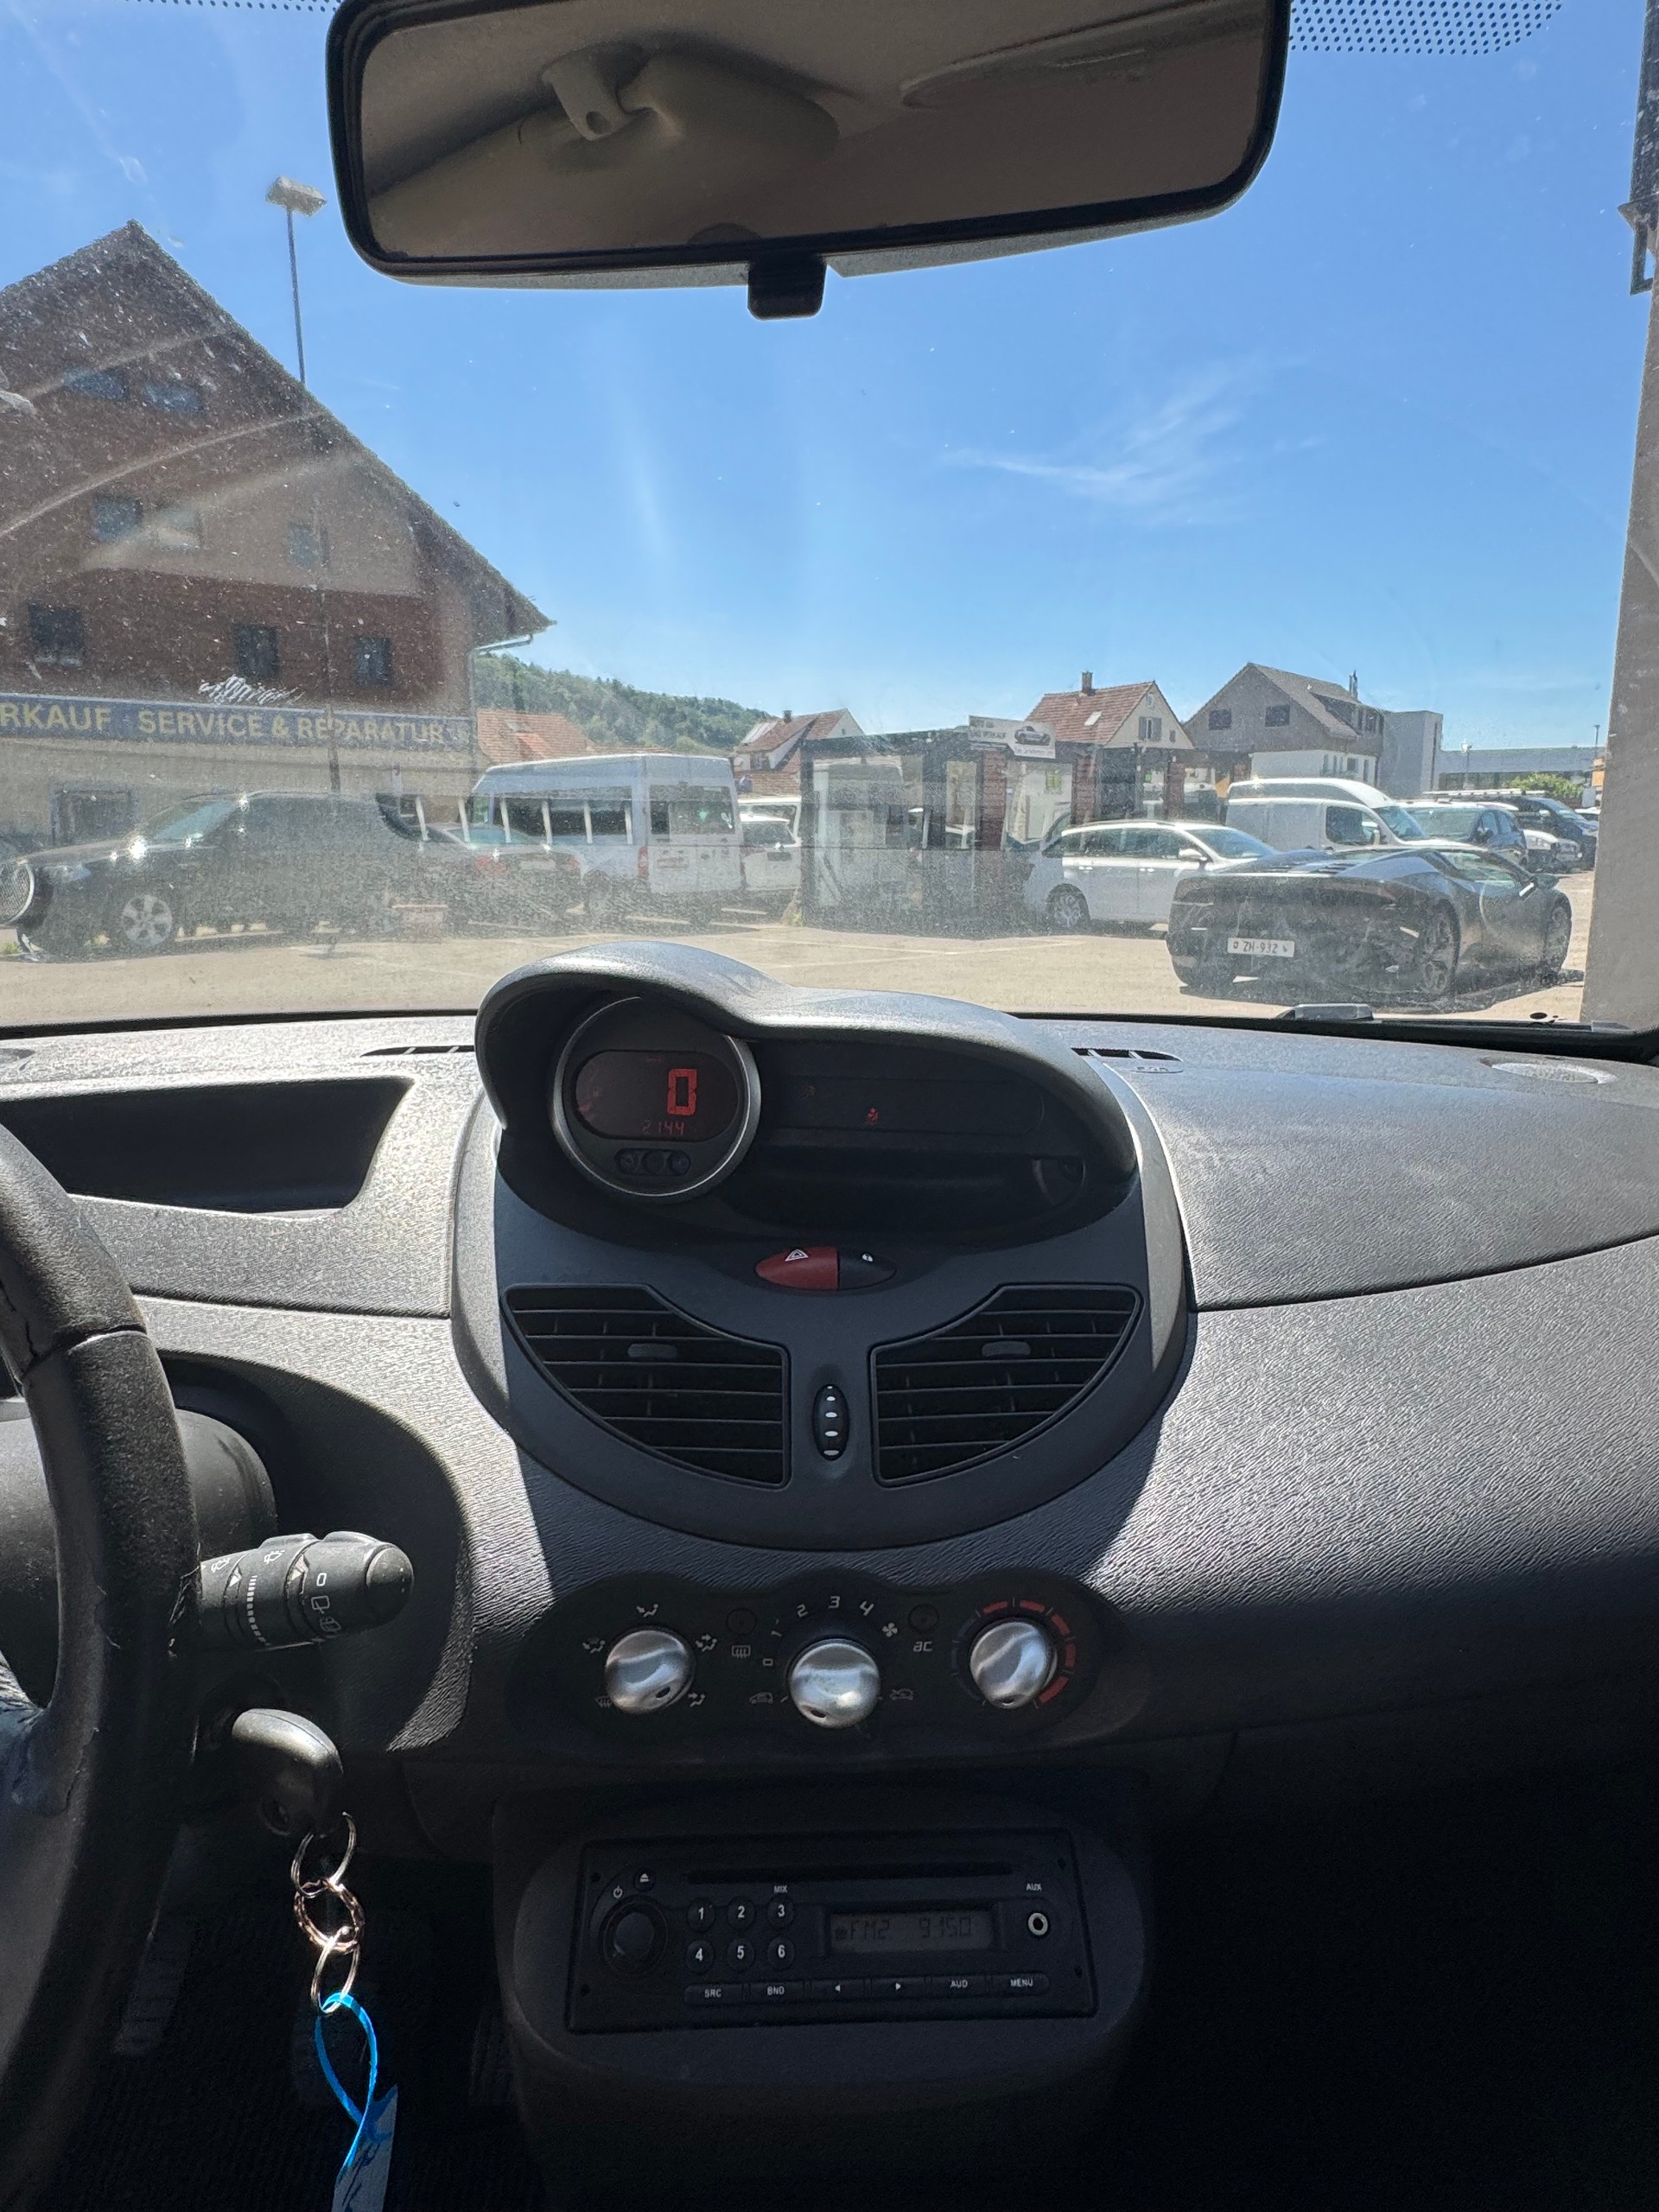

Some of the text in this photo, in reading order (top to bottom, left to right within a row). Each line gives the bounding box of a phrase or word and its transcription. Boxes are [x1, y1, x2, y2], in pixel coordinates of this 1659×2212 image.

[138, 709, 263, 736] SERVICE
[272, 715, 289, 735] &
[667, 1068, 697, 1115] 0
[828, 1595, 841, 1609] 3
[859, 1600, 874, 1617] 4
[796, 1604, 809, 1618] 2
[773, 1885, 788, 1893] MIX
[1026, 1883, 1042, 1891] AUX
[697, 1907, 704, 1921] 1
[737, 1905, 745, 1918] 2
[777, 1904, 785, 1917] 3
[695, 1948, 703, 1961] 4
[737, 1945, 745, 1959] 5
[777, 1944, 785, 1958] 6
[950, 1979, 969, 1988] AUD
[1009, 1978, 1033, 1987] MENU
[703, 1988, 722, 1999] SRC
[766, 1986, 785, 1995] BND
